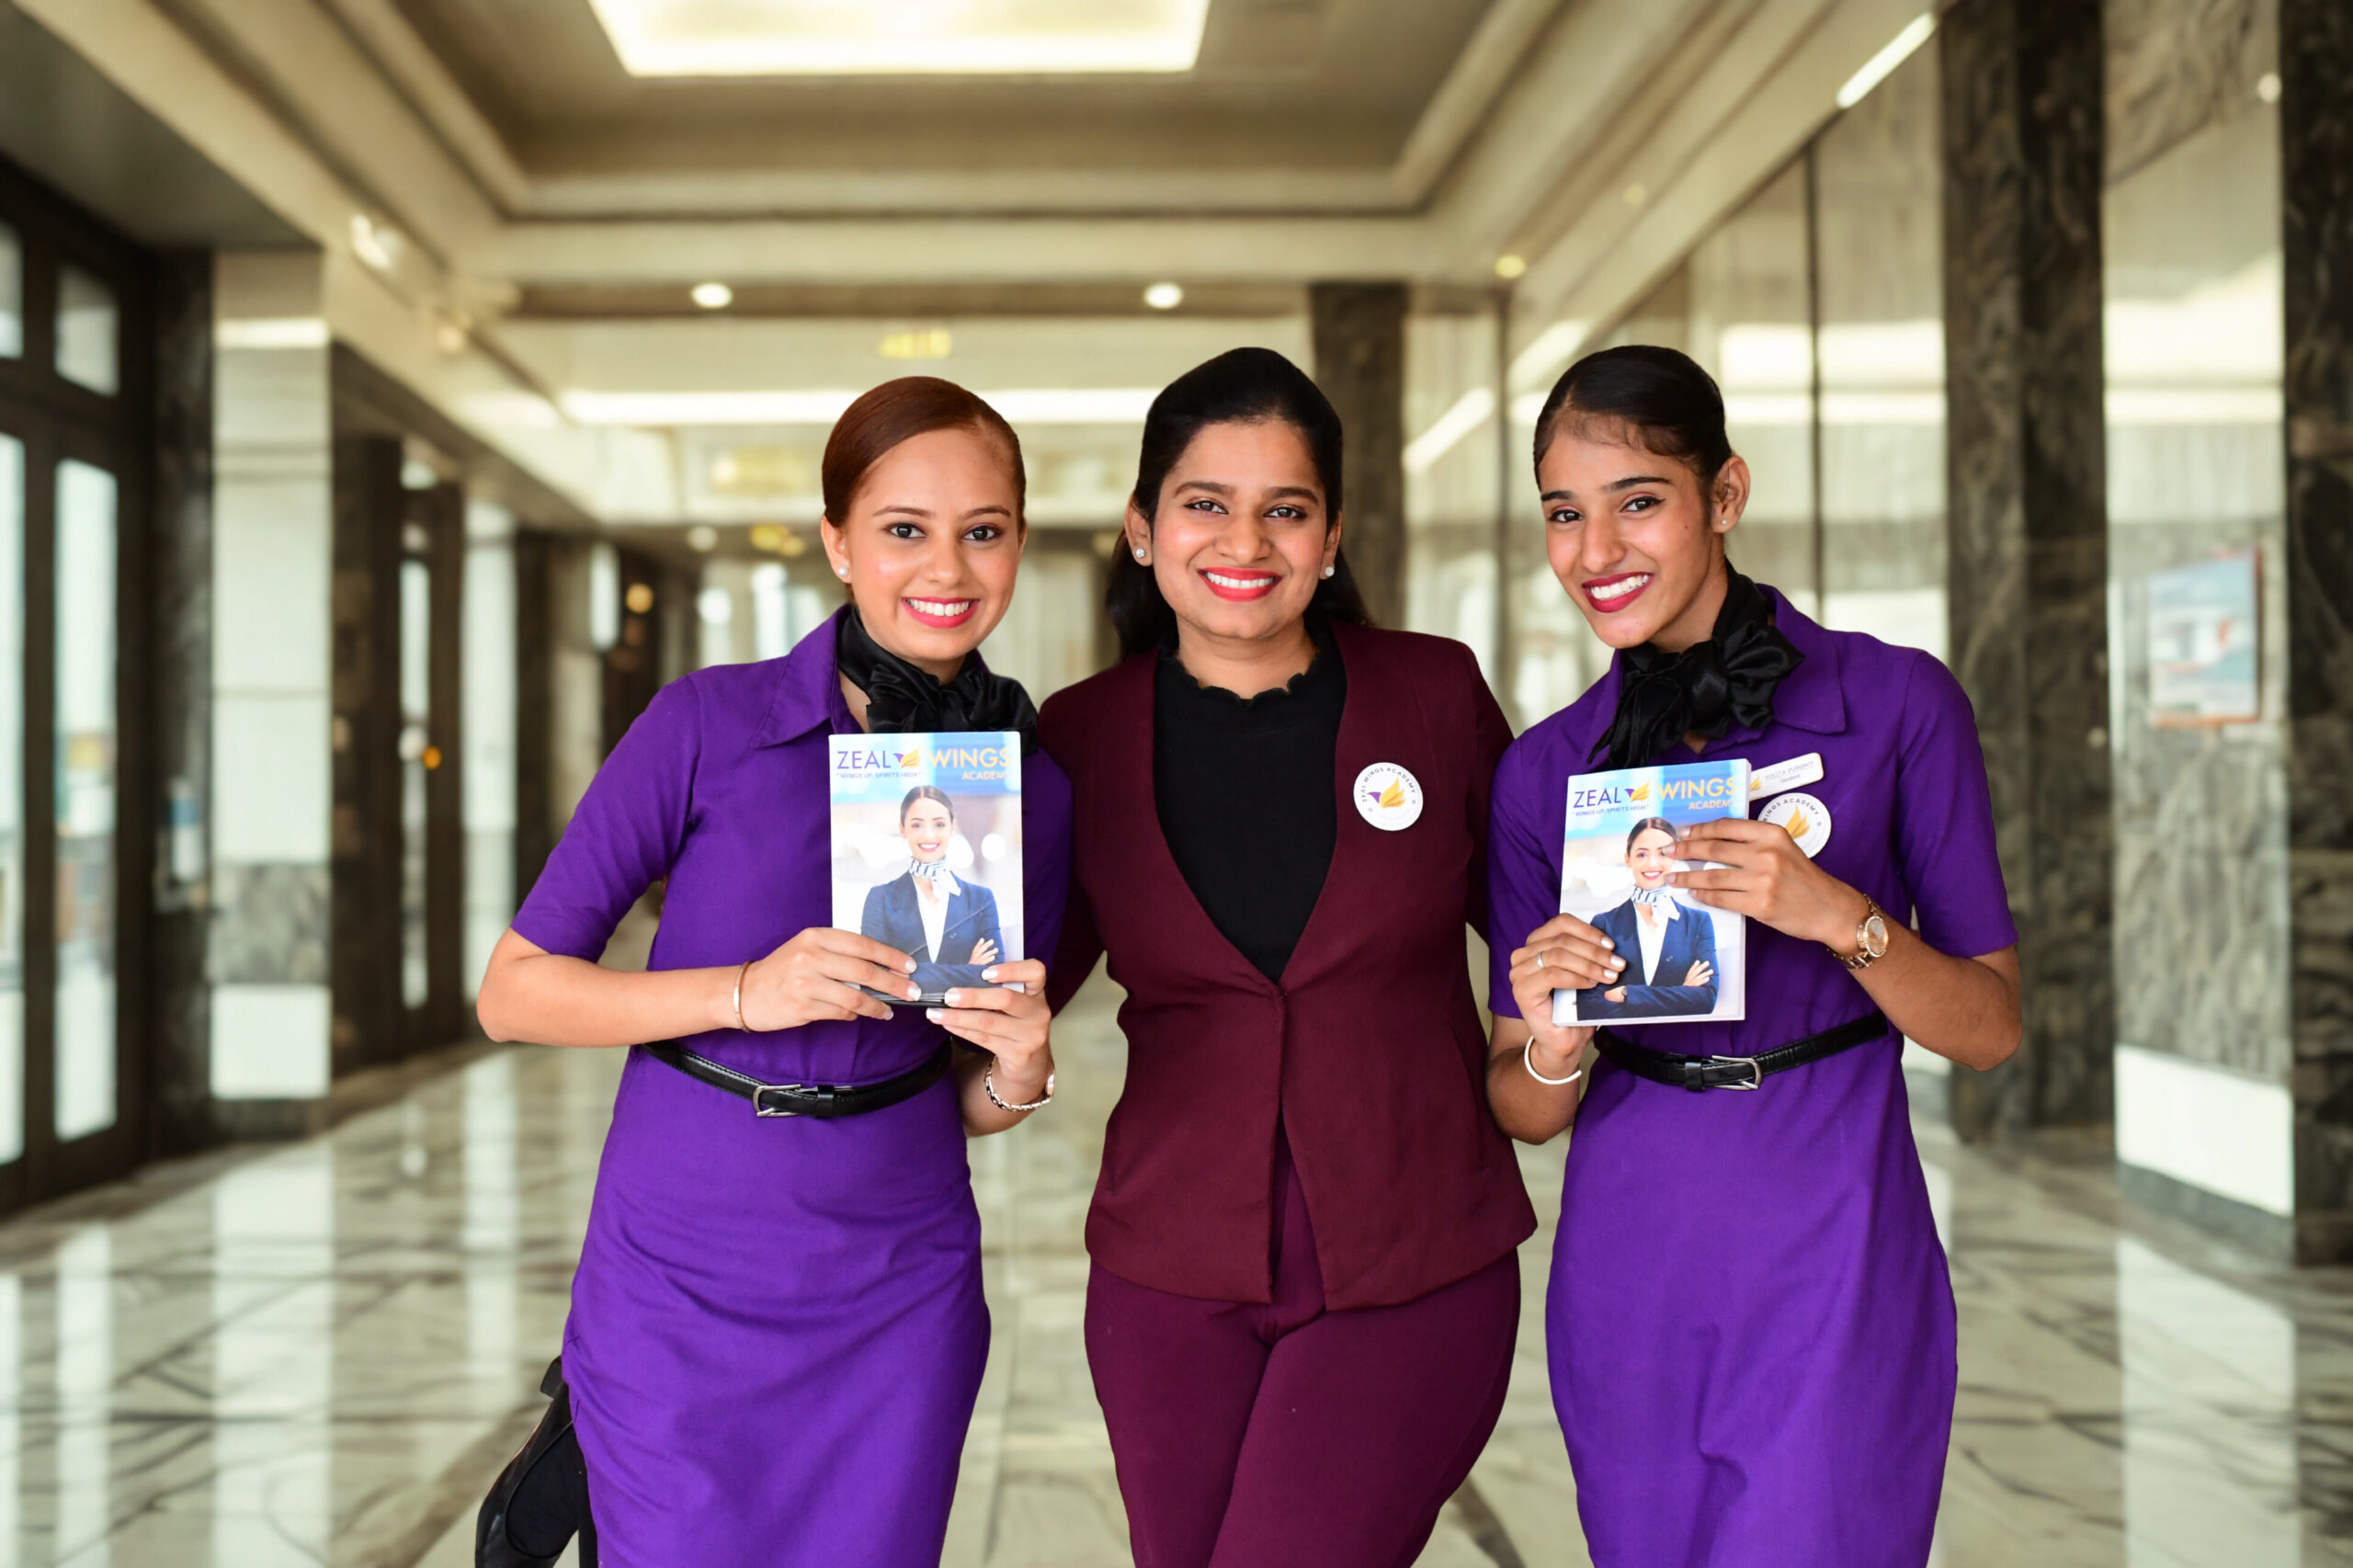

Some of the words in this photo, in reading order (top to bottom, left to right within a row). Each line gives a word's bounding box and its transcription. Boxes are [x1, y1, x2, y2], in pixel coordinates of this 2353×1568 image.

[837, 750, 891, 769] ZEAL
[927, 747, 1010, 767] WINGS
[961, 771, 1012, 780] ACADEM
[1387, 767, 1415, 793] ACADEMY
[1573, 787, 1621, 808] ZEAL
[1657, 778, 1736, 800] WINGS
[1783, 798, 1819, 815] ACADEMY
